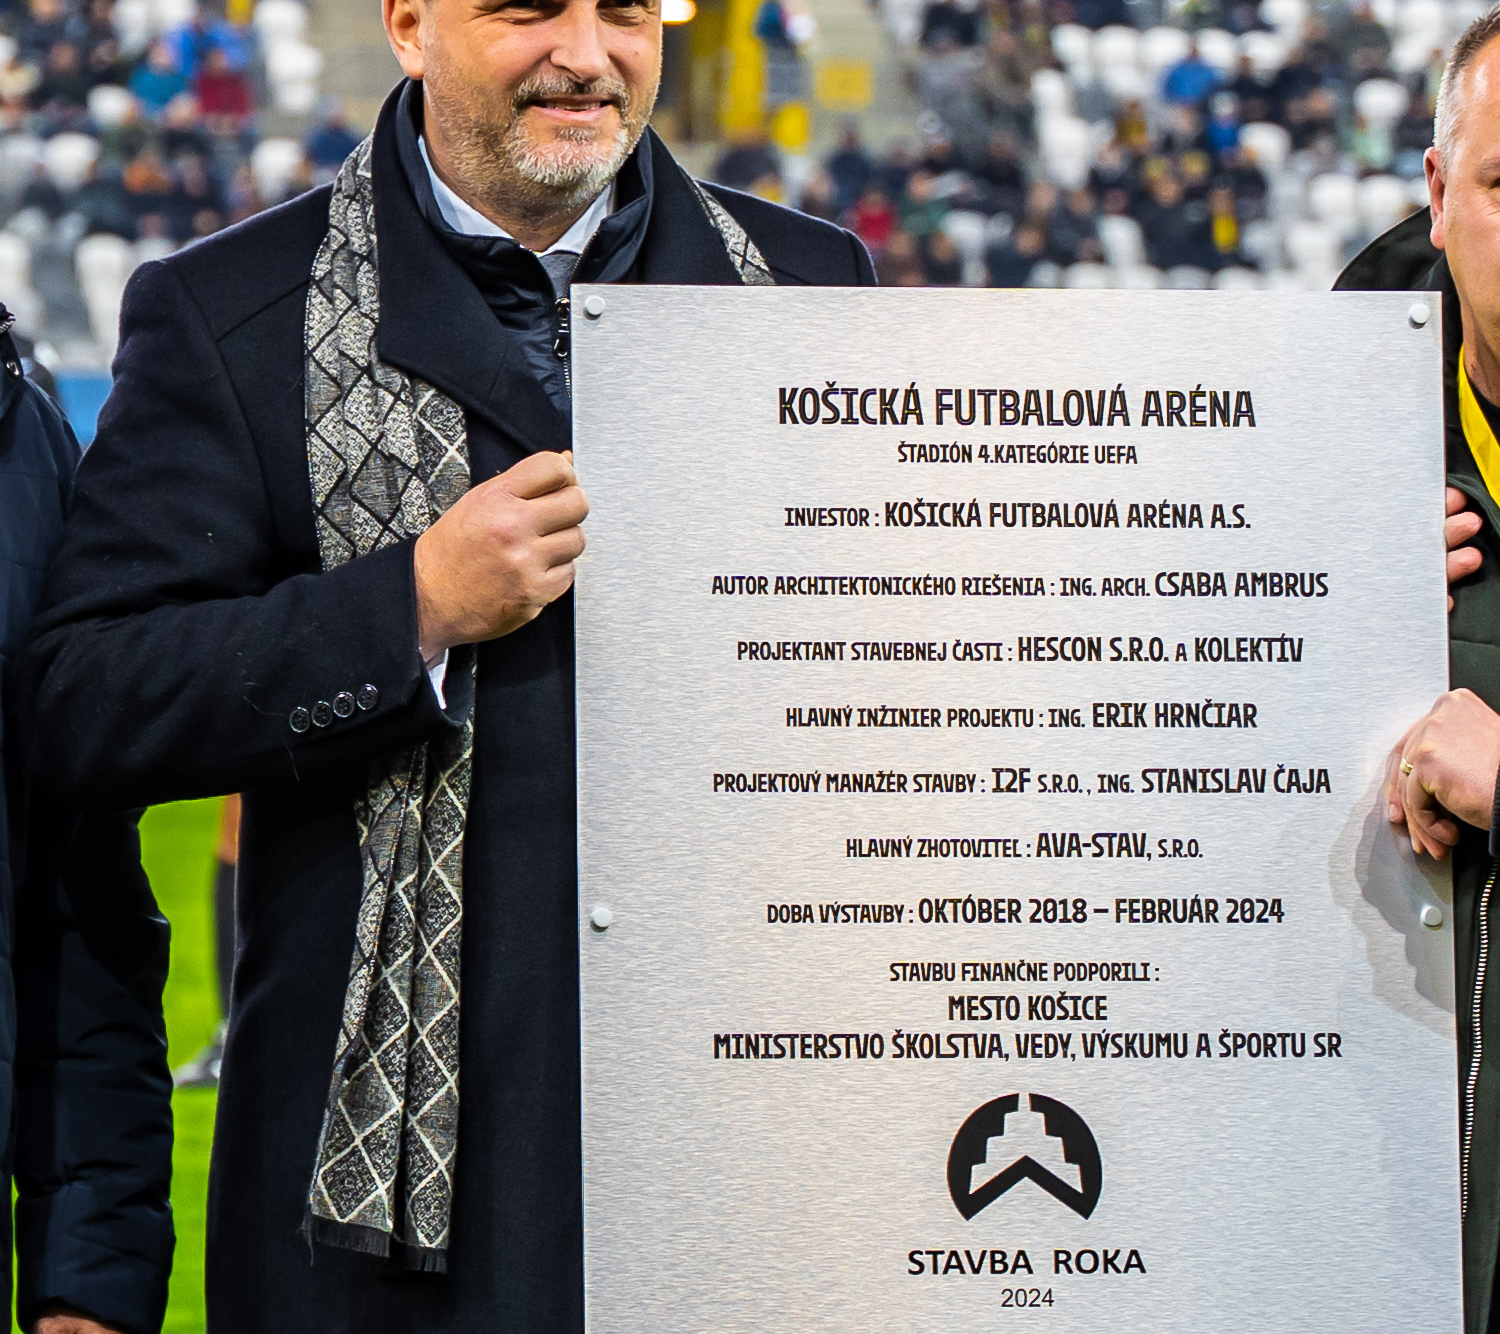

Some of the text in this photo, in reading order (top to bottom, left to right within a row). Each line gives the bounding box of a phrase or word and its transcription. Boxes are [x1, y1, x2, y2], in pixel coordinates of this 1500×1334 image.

[778, 380, 1257, 428] KOŠICKÁ FUTBALOVÁ ARÉNA
[897, 440, 1138, 465] ŠTADIÓN 4.KATEGÓRIE UEFA
[784, 507, 870, 527] INVESTOR
[884, 497, 982, 528] KOŠICKÁ
[989, 498, 1120, 528] FUTBALOVÁ
[1126, 498, 1204, 529] ARÉNA
[1210, 503, 1251, 529] A.S.
[711, 575, 769, 596] AUTOR
[773, 573, 957, 596] ARCHITEKTONICKÉHO
[961, 573, 1046, 597] RIEŠENIA
[1059, 577, 1097, 597] ING.
[1101, 577, 1151, 597] ARCH.
[1154, 571, 1228, 597] CSABA
[1234, 572, 1329, 598] AMBRUS
[737, 641, 847, 661] PROJEKTANT
[850, 641, 947, 662] STAVEBNEJ
[952, 638, 1004, 662] ČASTI
[1017, 636, 1102, 662] HESCON
[1109, 636, 1170, 663] S.R.O.
[1174, 642, 1188, 662] A
[1194, 632, 1304, 663] KOLEKTÍV
[785, 704, 854, 728] HLAVNÝ
[856, 704, 942, 728] INŽINIER
[946, 708, 1034, 728] PROJEKTU
[1047, 708, 1086, 728] ING.
[1092, 702, 1148, 728] ERIK
[1154, 698, 1258, 729] HRNČIAR
[713, 769, 822, 793] PROJEKTOVÝ
[825, 769, 908, 794] MANAŽÉR
[912, 773, 977, 793] STAVBY
[991, 767, 1032, 794] I2F
[1037, 773, 1083, 794] S.R.O.
[1096, 773, 1135, 794] ING.
[1141, 767, 1267, 794] STANISLAV
[1273, 763, 1332, 794] ČAJA
[846, 834, 913, 858] HLAVNÝ
[1035, 832, 1152, 862] AVA-STAV,
[1157, 838, 1204, 858] S.R.O.
[767, 903, 815, 924] DOBA
[818, 900, 905, 924] VÝSTAVBY
[918, 893, 1022, 924] OKTÓBER
[1028, 897, 1088, 924] 2018
[1115, 893, 1220, 924] FEBRUÁR
[1225, 897, 1286, 924] 2024
[889, 962, 956, 982] STAVBU
[961, 959, 1049, 982] FINANČNE
[1053, 962, 1151, 982] PODPORILI
[948, 990, 1108, 1021] MESTO KOŠICE
[713, 1028, 1343, 1062] MINISTERSTVO ŠKOLSTVA, VEDY, VÝSKUMU A ŠPORTU SR
[907, 1248, 1147, 1276] STAVBA ROKA
[1000, 1288, 1055, 1308] 2024
